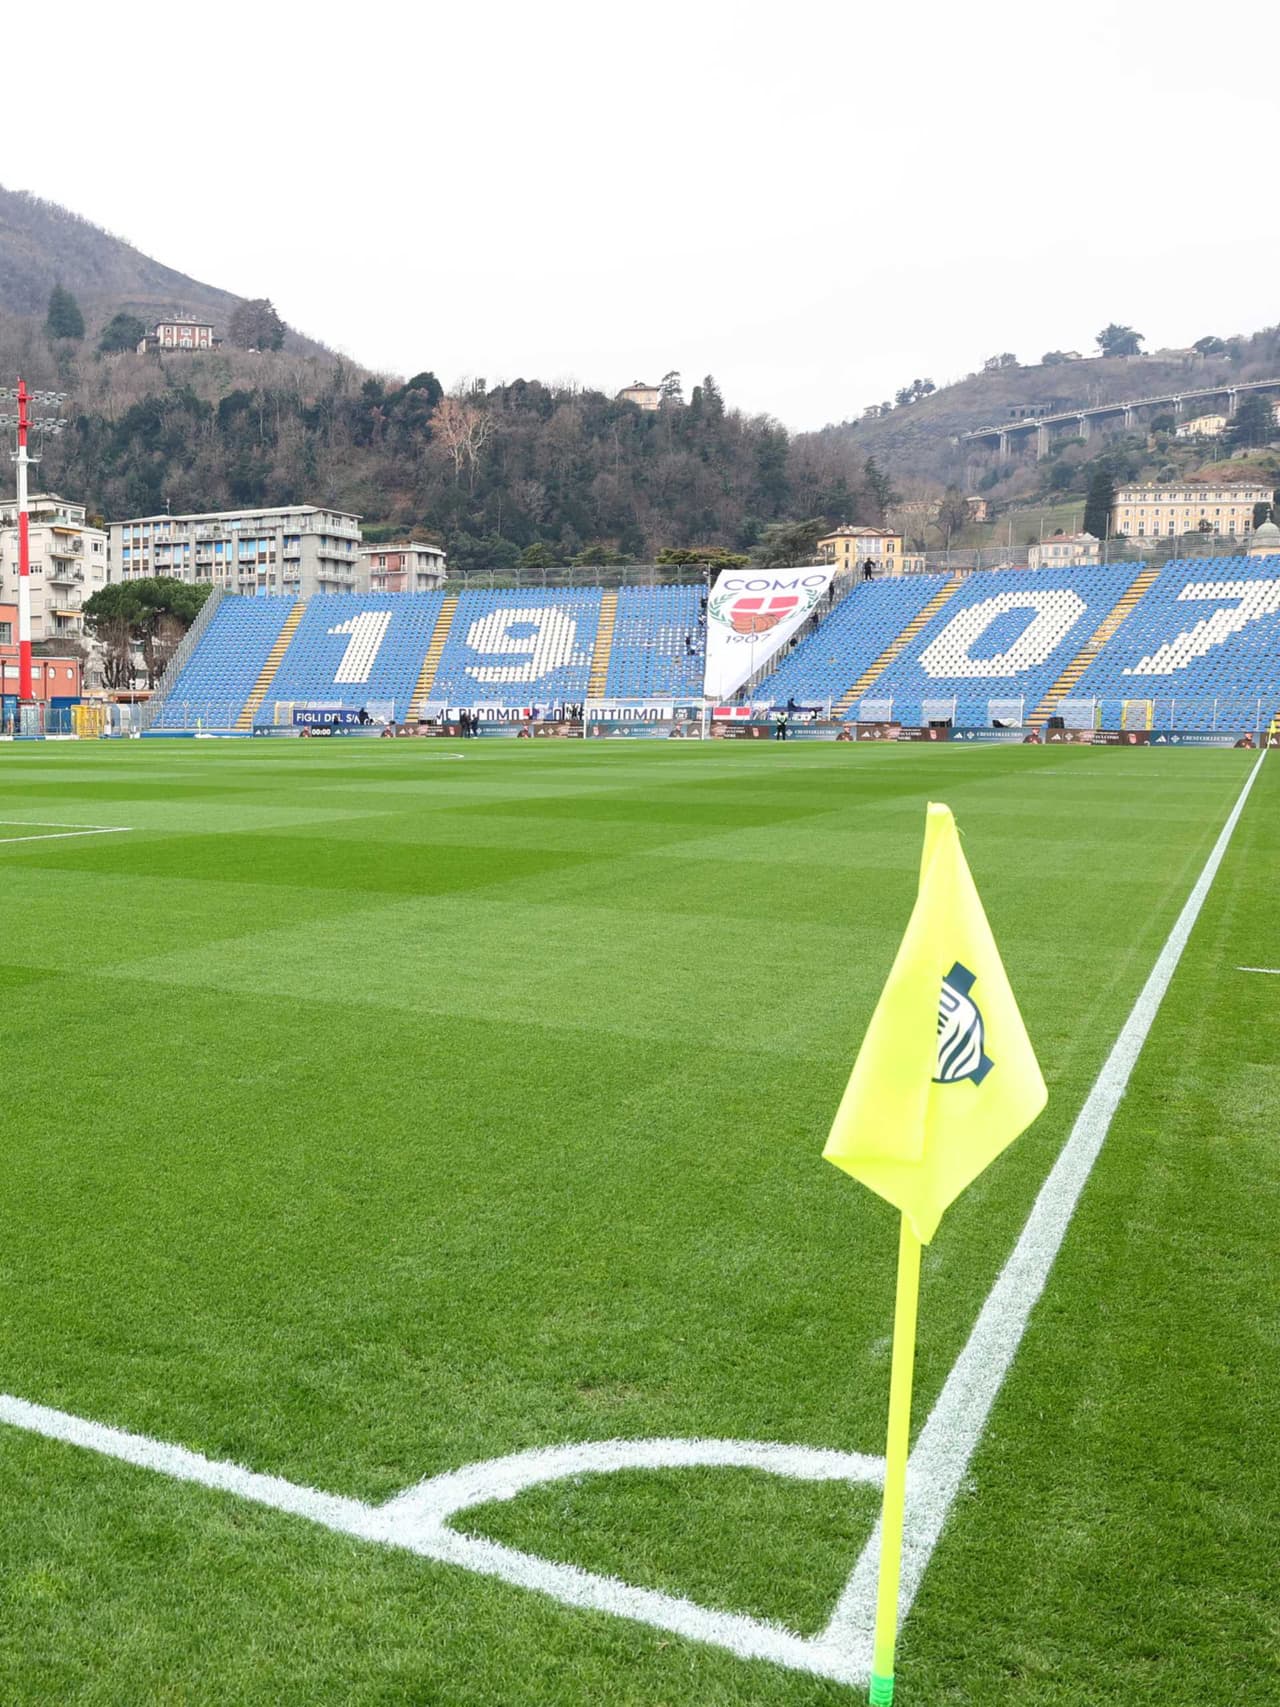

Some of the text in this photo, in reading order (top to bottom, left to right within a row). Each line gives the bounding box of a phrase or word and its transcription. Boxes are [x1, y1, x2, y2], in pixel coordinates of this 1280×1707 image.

[723, 575, 827, 592] COMO
[726, 633, 772, 644] 1907
[296, 713, 321, 722] FIGLI
[311, 728, 331, 736] 00:00
